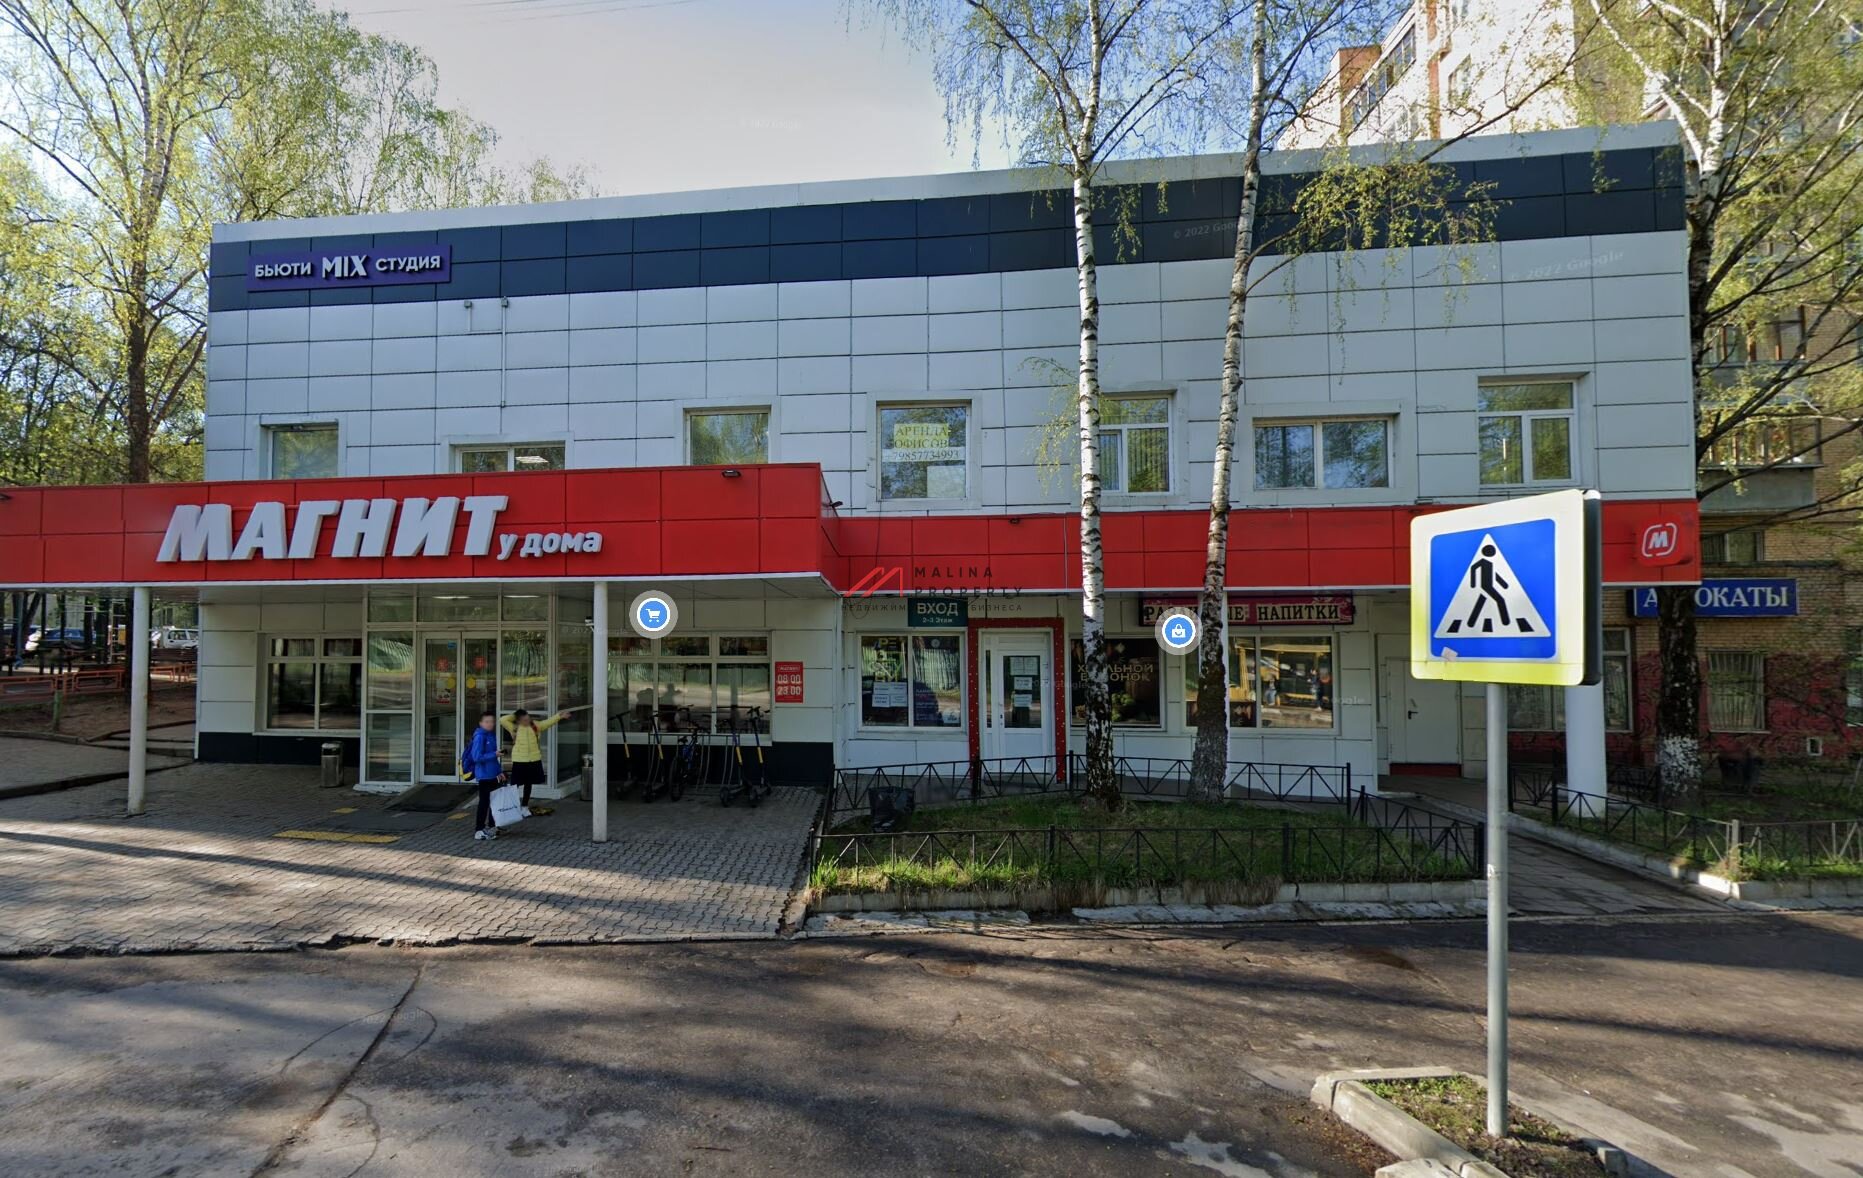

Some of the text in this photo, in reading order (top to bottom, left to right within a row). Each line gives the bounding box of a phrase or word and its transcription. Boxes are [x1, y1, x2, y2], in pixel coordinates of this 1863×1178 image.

[254, 254, 441, 280] БЬЮТИ MIX СТУДИЯ
[895, 426, 948, 437] АРЕНДА
[894, 437, 948, 449] ОФИСОВ
[156, 495, 508, 562] МАГНИТ
[519, 530, 603, 557] дома
[1643, 585, 1789, 608] АОКАТЫ
[916, 602, 959, 617] ВХОД
[1257, 604, 1340, 621] НАПИТКИ
[1077, 663, 1154, 673] ХЛЬНОЙ
[1080, 672, 1151, 682] БОНОК
